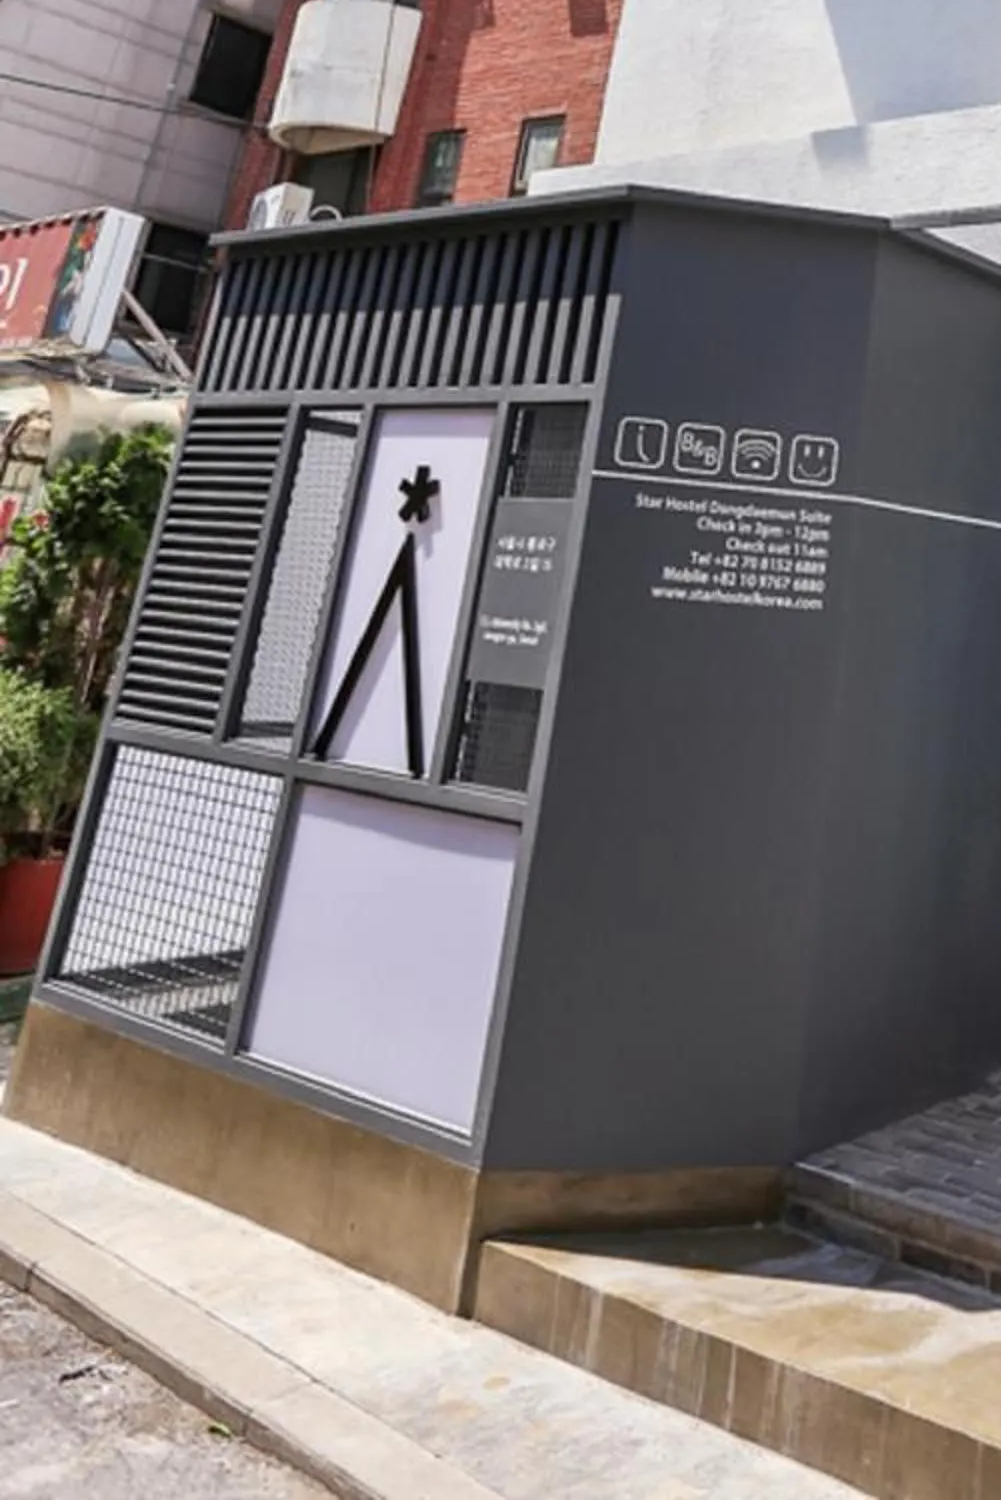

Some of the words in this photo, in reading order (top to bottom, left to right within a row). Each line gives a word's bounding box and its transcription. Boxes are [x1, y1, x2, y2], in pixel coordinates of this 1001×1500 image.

[635, 492, 664, 508] Star
[665, 495, 707, 514] Hostel
[697, 515, 736, 534] Check
[726, 536, 765, 553] Check
[662, 565, 709, 584] Mobile
